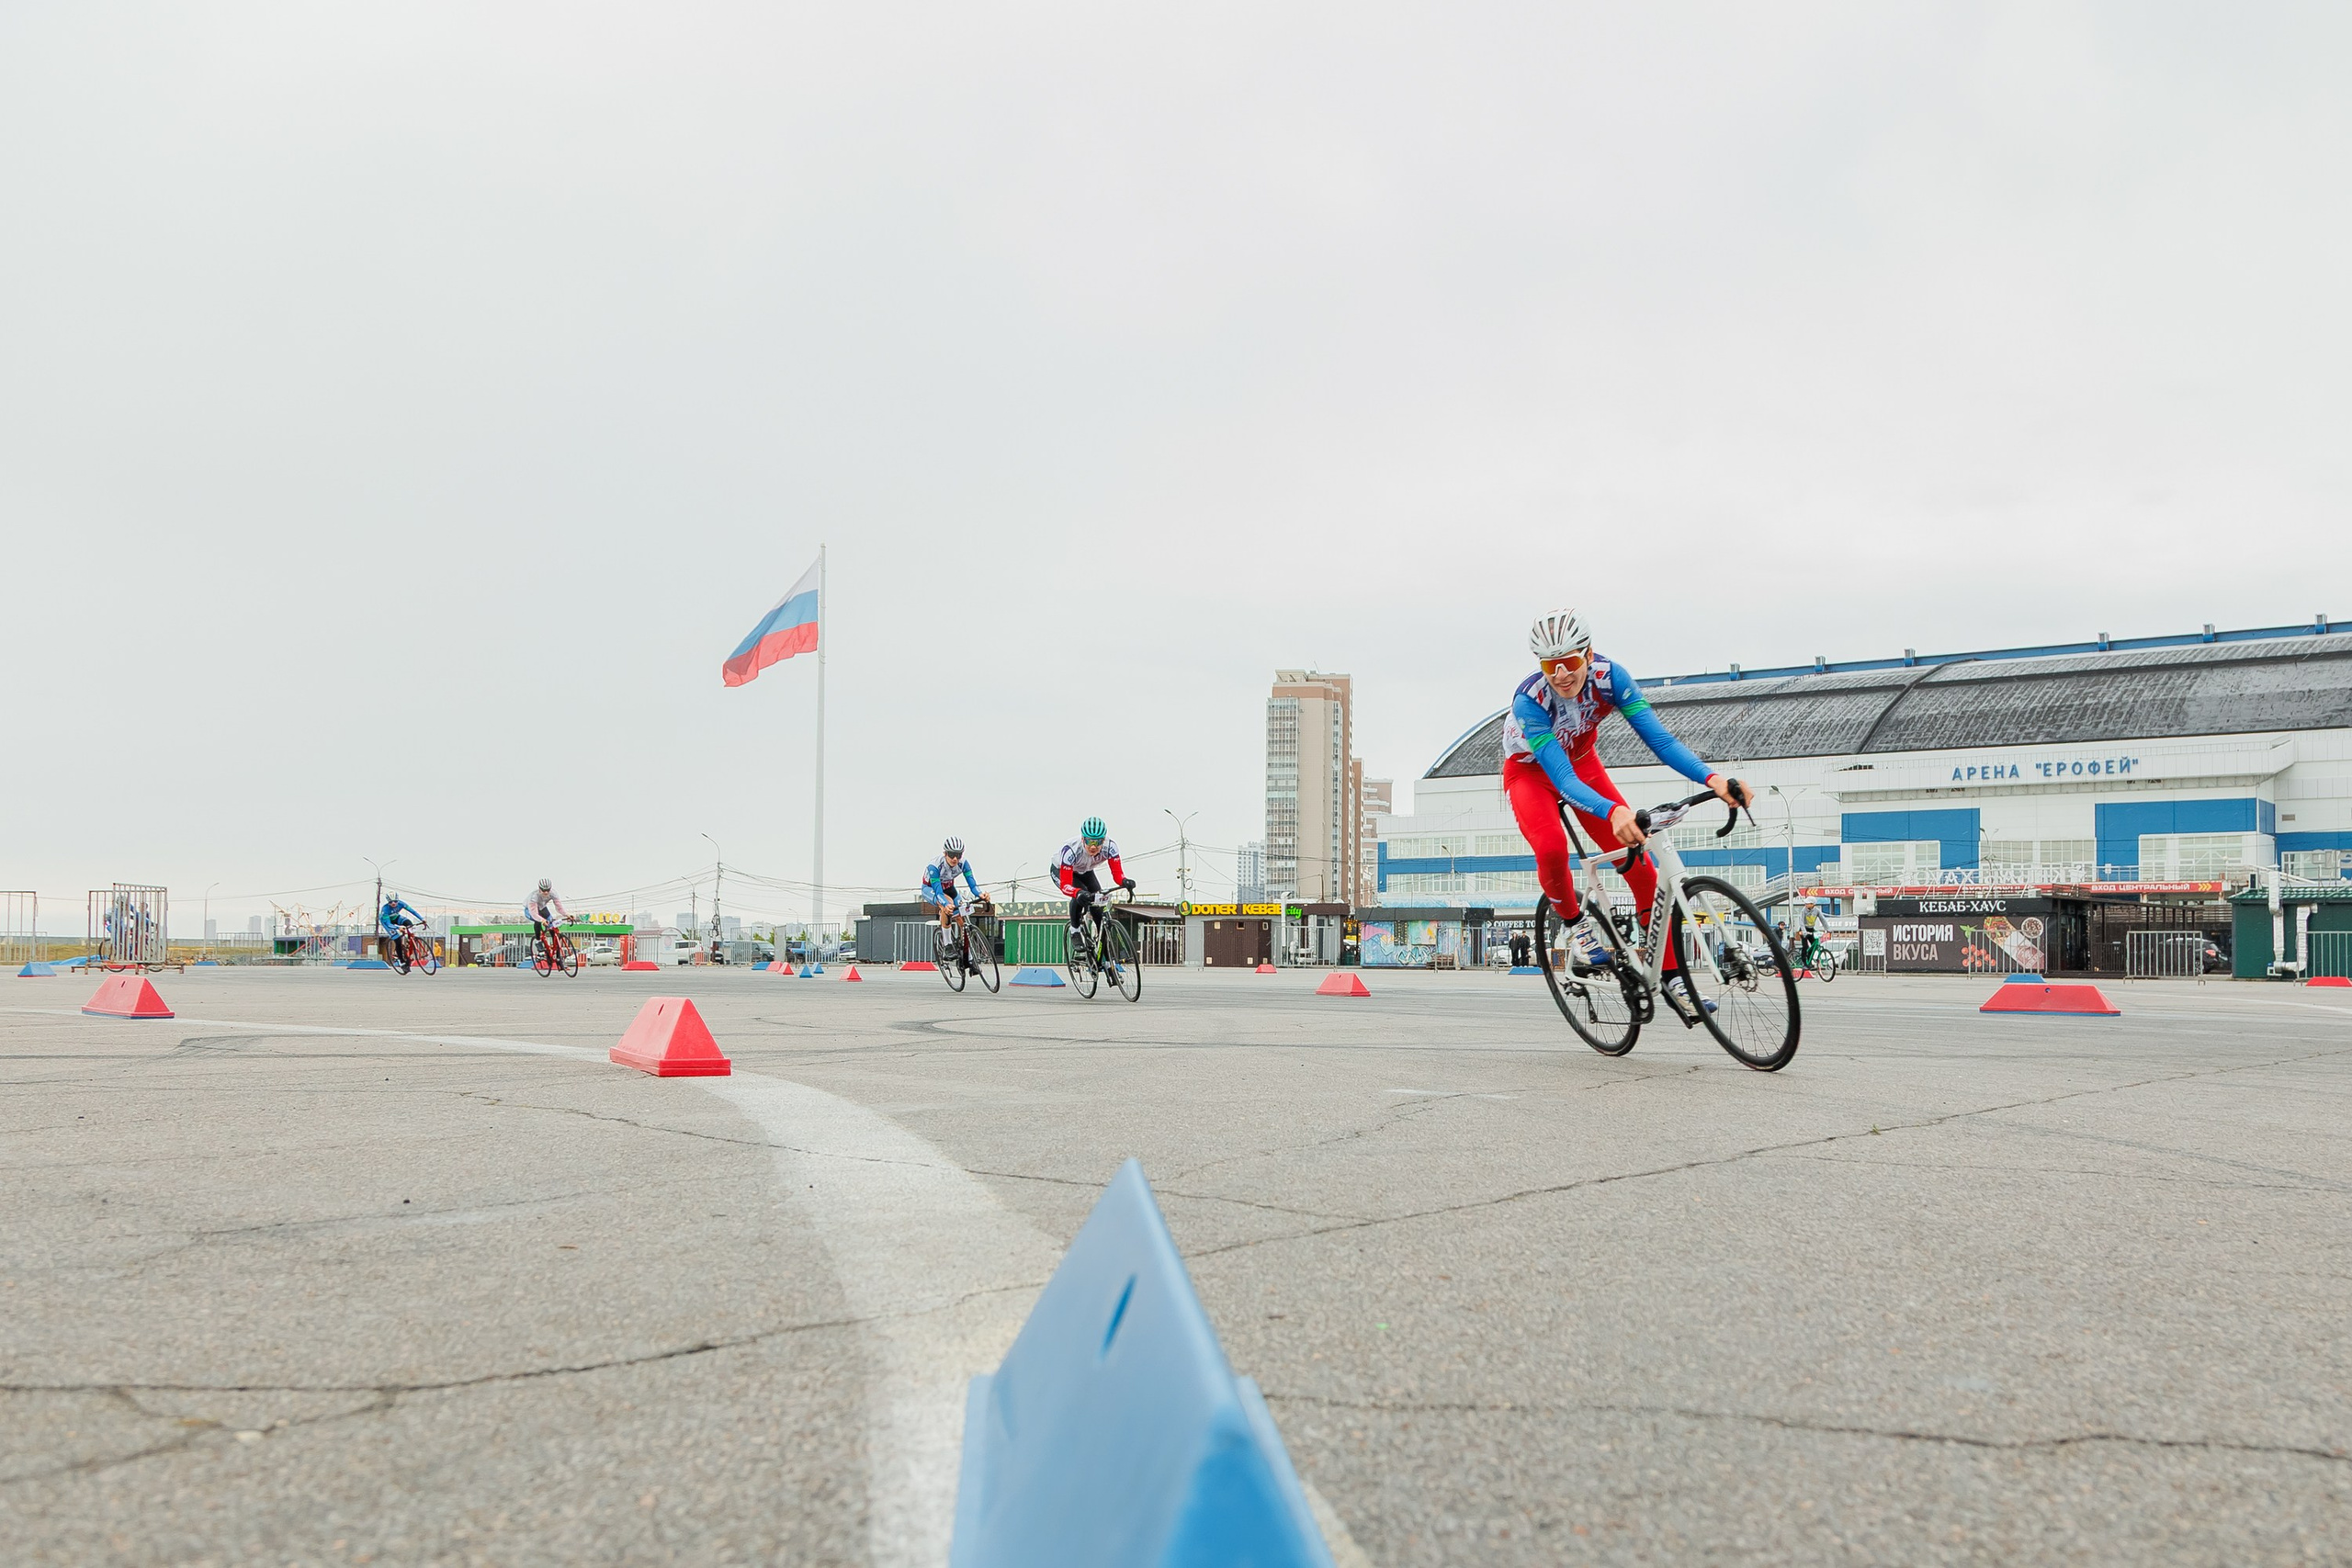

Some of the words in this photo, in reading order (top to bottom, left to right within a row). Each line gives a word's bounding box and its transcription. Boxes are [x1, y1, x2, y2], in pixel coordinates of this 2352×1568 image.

[1951, 764, 2019, 781] АРЕНА
[2035, 756, 2139, 777] "ЕРОФЕЙ"
[2119, 883, 2190, 891] ЦЕНТРАЛЬНЫЙ
[1919, 900, 2007, 913] КЕБАБ-ХАУС
[1493, 919, 1524, 929] COFFEE
[1525, 919, 1550, 929] TON
[1645, 886, 1666, 968] Bianchi
[1893, 924, 1954, 942] ИСТОРИЯ
[1893, 943, 1939, 961] ВКУСА
